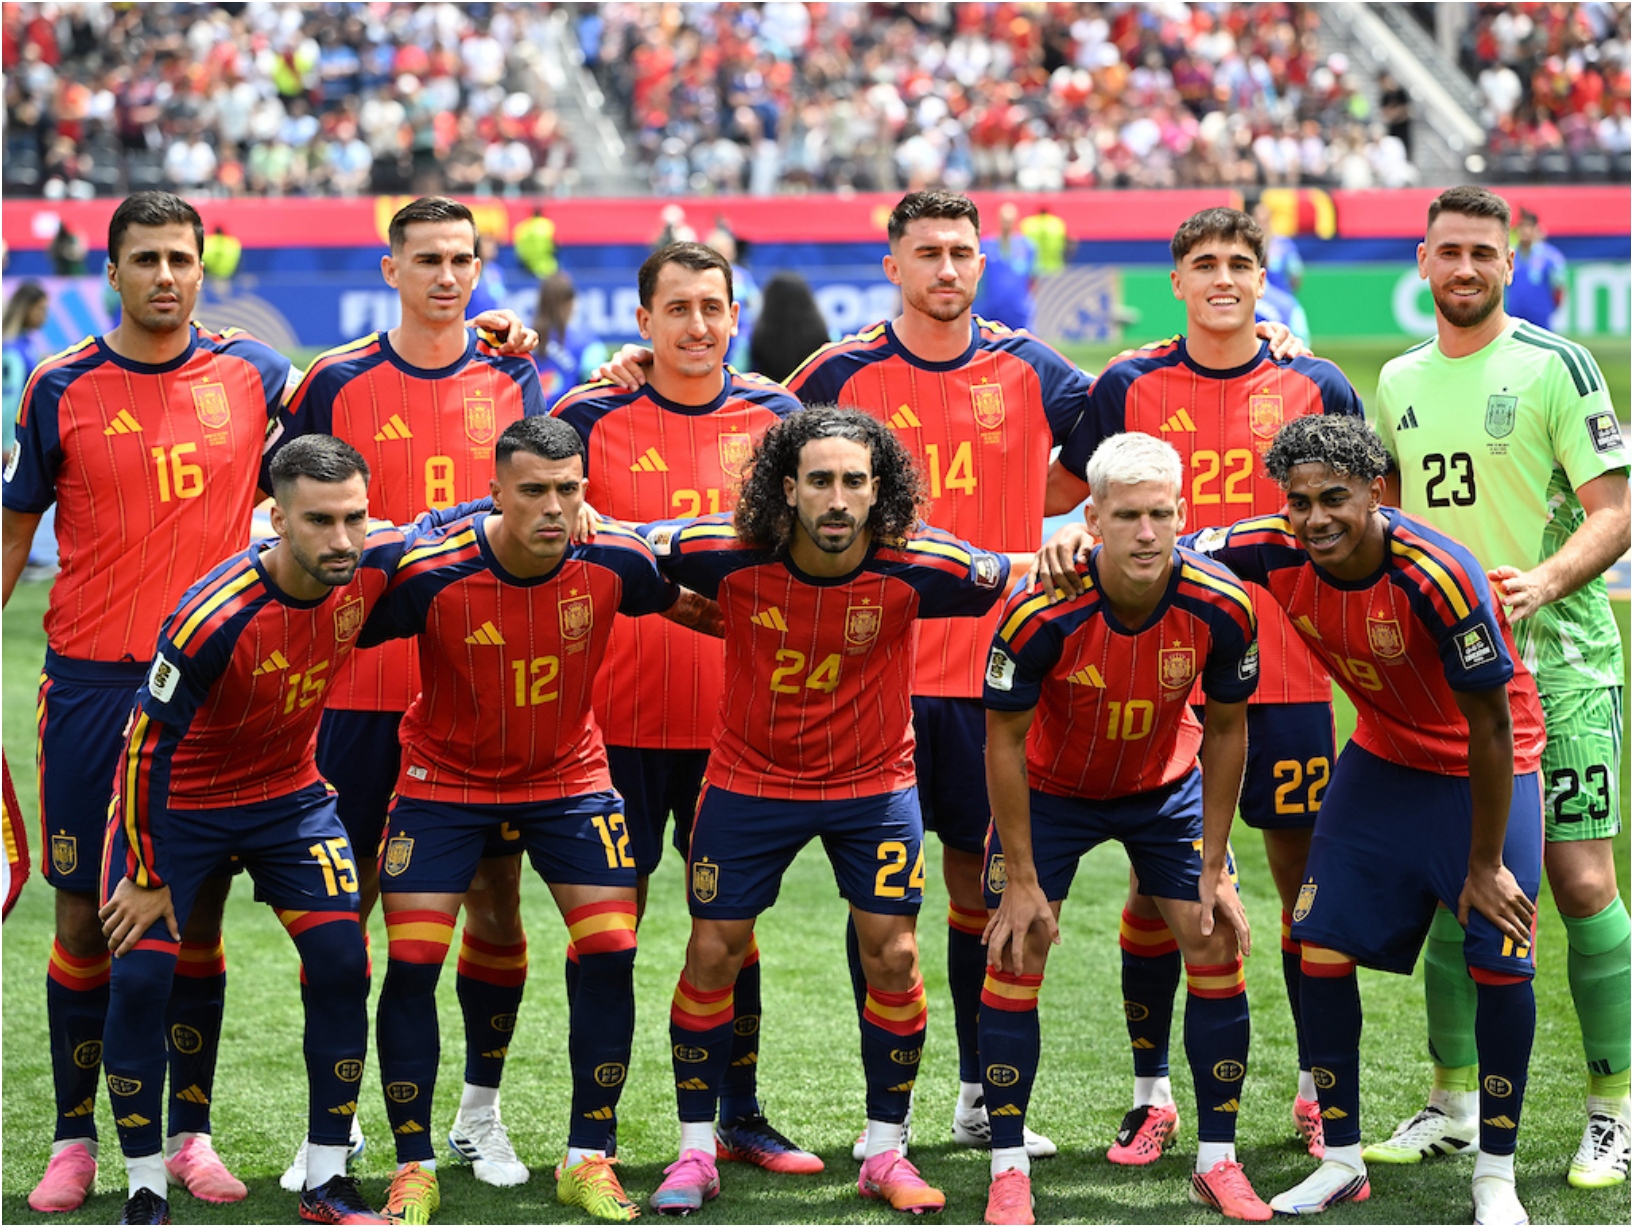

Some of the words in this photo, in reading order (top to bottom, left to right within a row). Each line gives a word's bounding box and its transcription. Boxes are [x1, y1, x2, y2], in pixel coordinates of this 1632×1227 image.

[152, 443, 204, 502] 16
[425, 456, 455, 509] 8
[926, 441, 977, 498] 14
[1191, 450, 1253, 505] 22
[1423, 452, 1477, 508] 23
[283, 660, 329, 715] 15
[512, 656, 560, 707] 12
[769, 649, 841, 694] 24
[1330, 651, 1384, 692] 19
[1107, 700, 1154, 741] 10
[1273, 757, 1330, 815] 22
[1552, 764, 1611, 824] 23
[309, 838, 360, 897] 15
[591, 814, 635, 870] 12
[874, 840, 925, 897] 24
